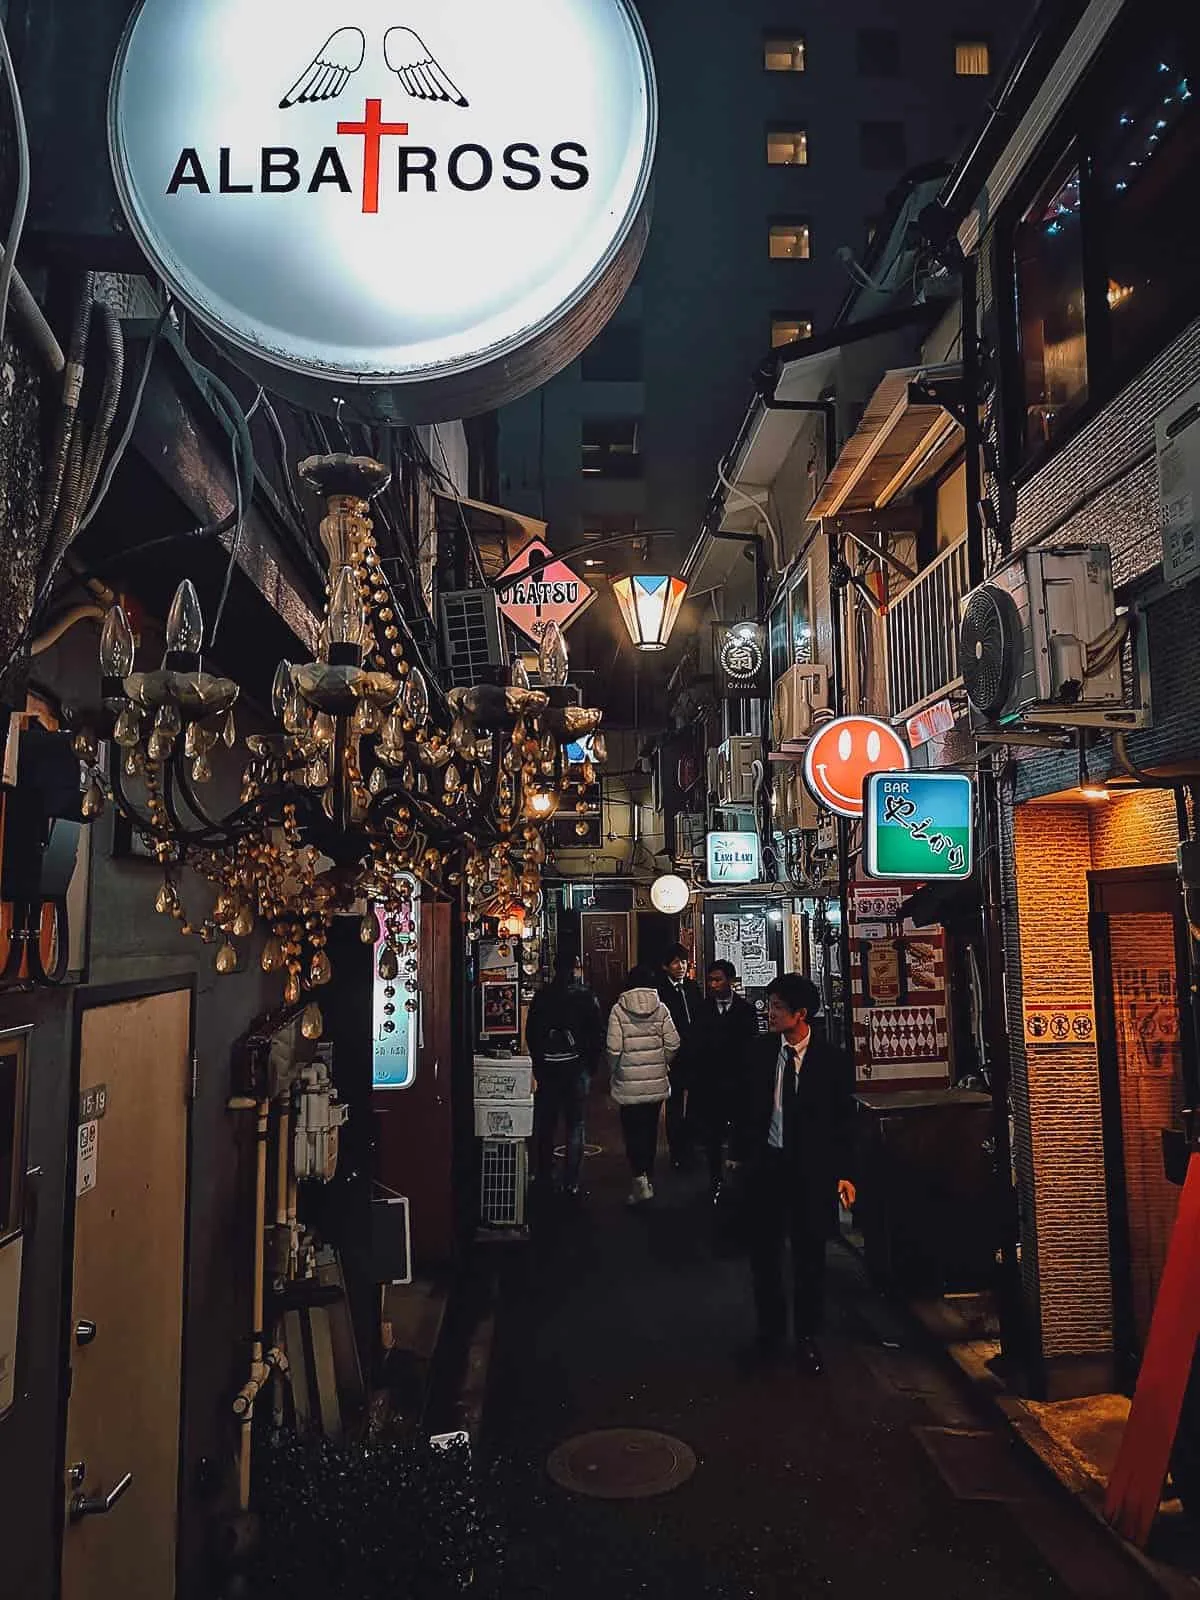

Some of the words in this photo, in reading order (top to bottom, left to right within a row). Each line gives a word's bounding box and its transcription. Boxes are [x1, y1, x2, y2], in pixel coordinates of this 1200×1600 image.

[165, 98, 591, 214] ALBATROSS
[884, 782, 910, 793] BAR
[883, 795, 965, 870] やどかり
